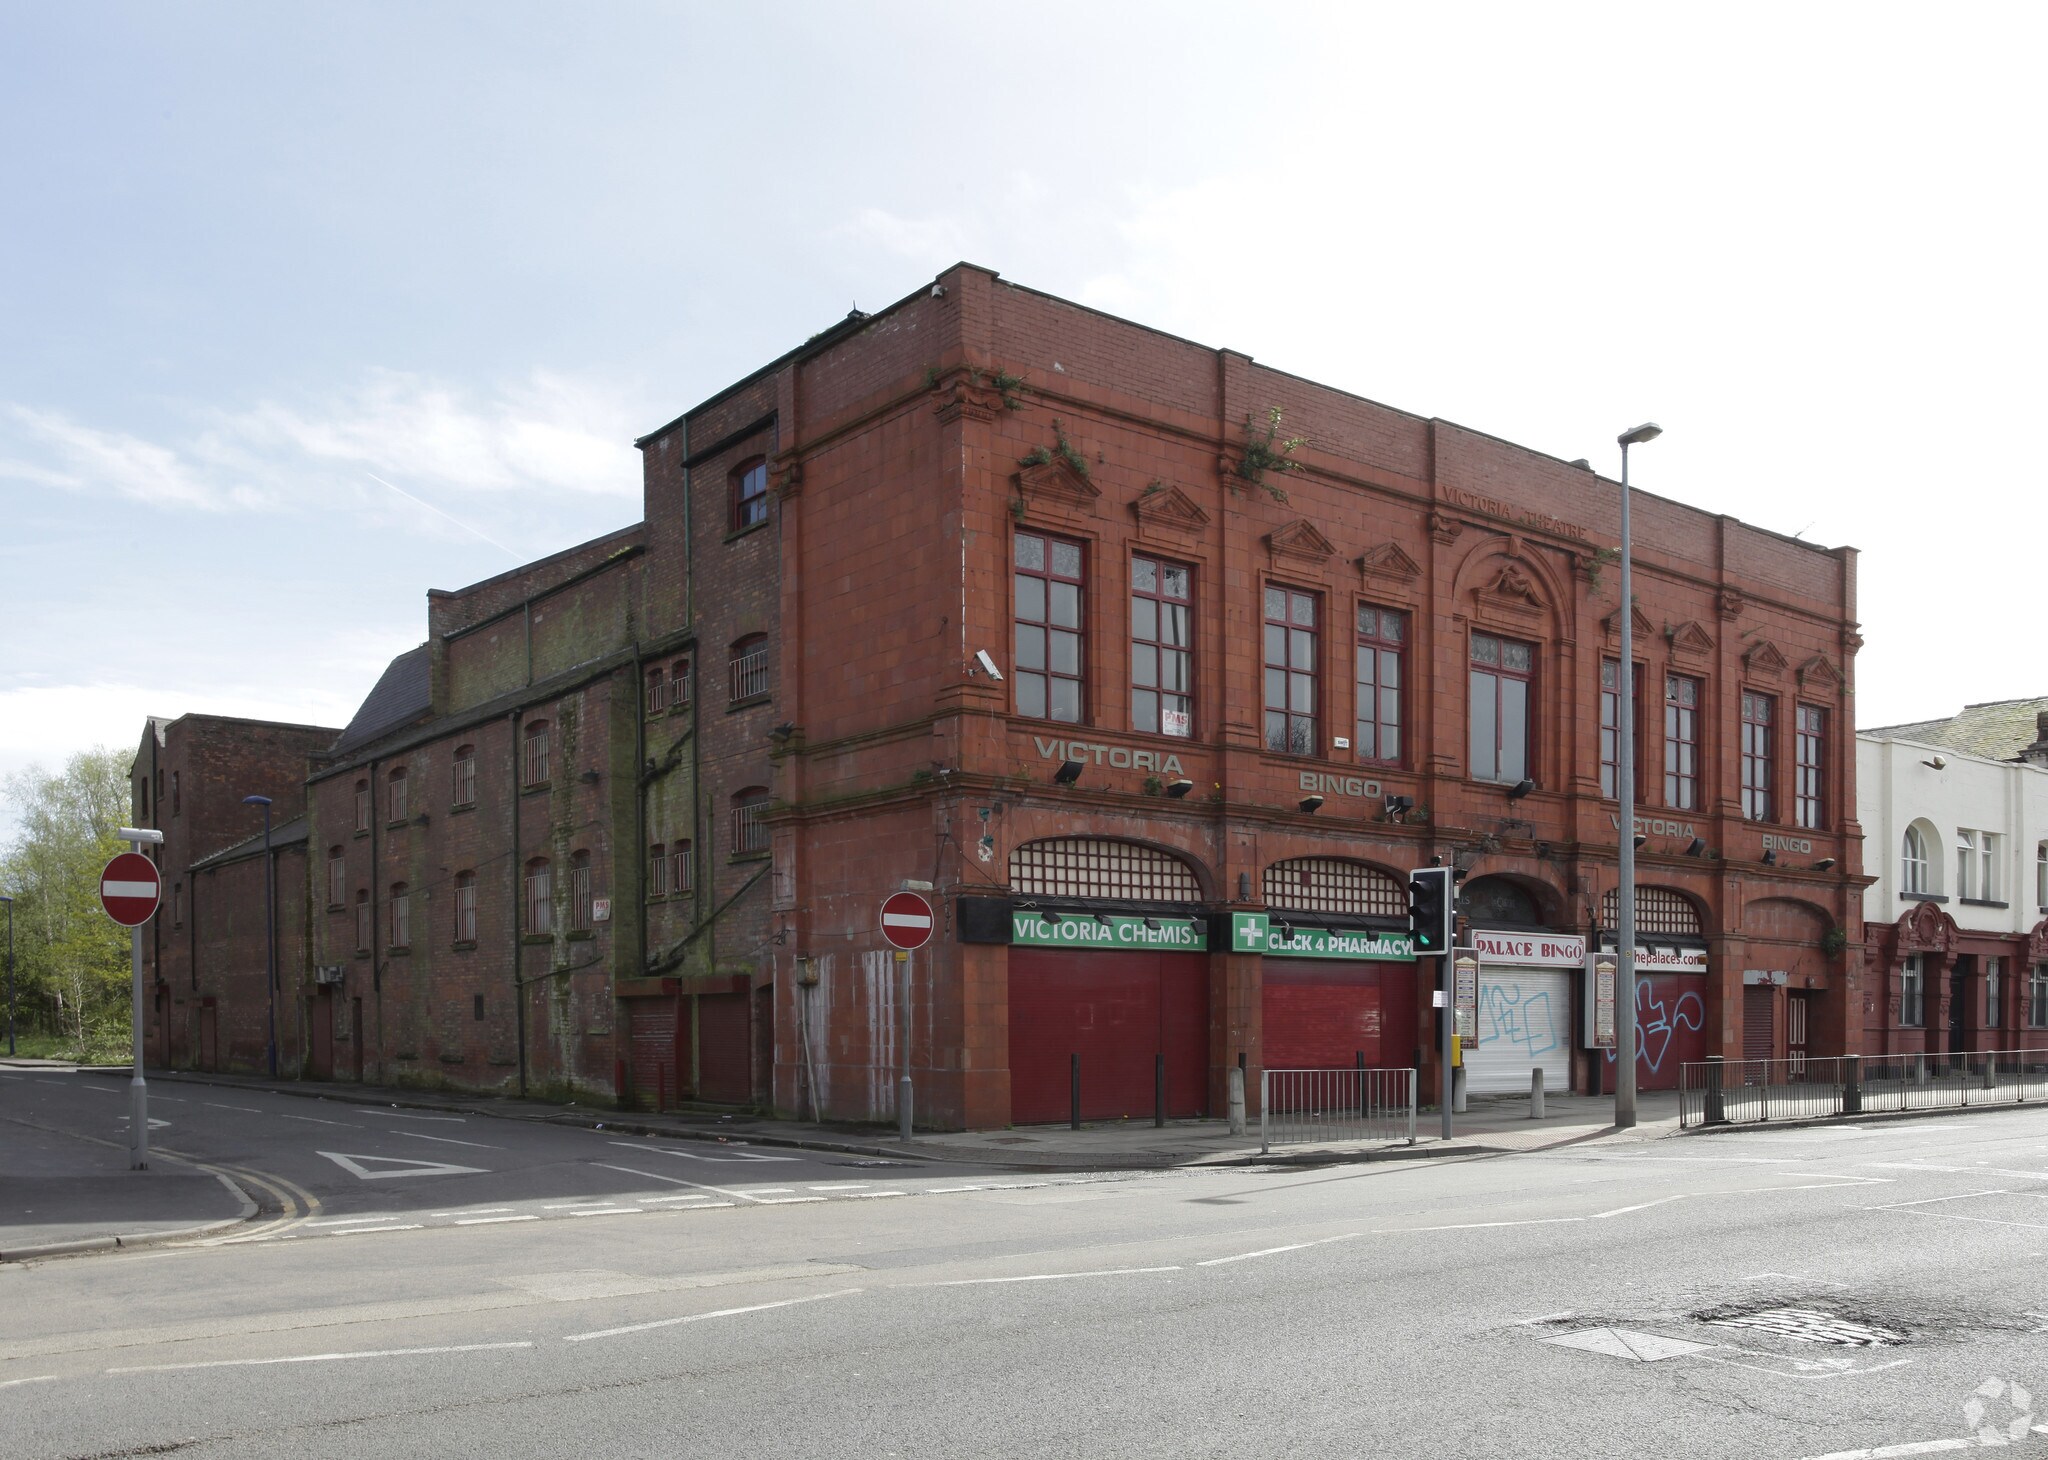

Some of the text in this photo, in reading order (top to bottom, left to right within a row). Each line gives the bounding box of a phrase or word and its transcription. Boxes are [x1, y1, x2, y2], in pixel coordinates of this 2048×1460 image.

[1443, 486, 1587, 540] VICTORIA THEATRE
[1033, 736, 1184, 775] VICTORIA
[1300, 771, 1381, 798] BINGO
[1610, 814, 1695, 839] VCTORIA
[1762, 834, 1811, 854] BINGO
[1014, 918, 1113, 941] VICTORIA
[1268, 933, 1411, 956] CLICK 4 PHARMACY
[1476, 940, 1582, 959] PALACE BINGO
